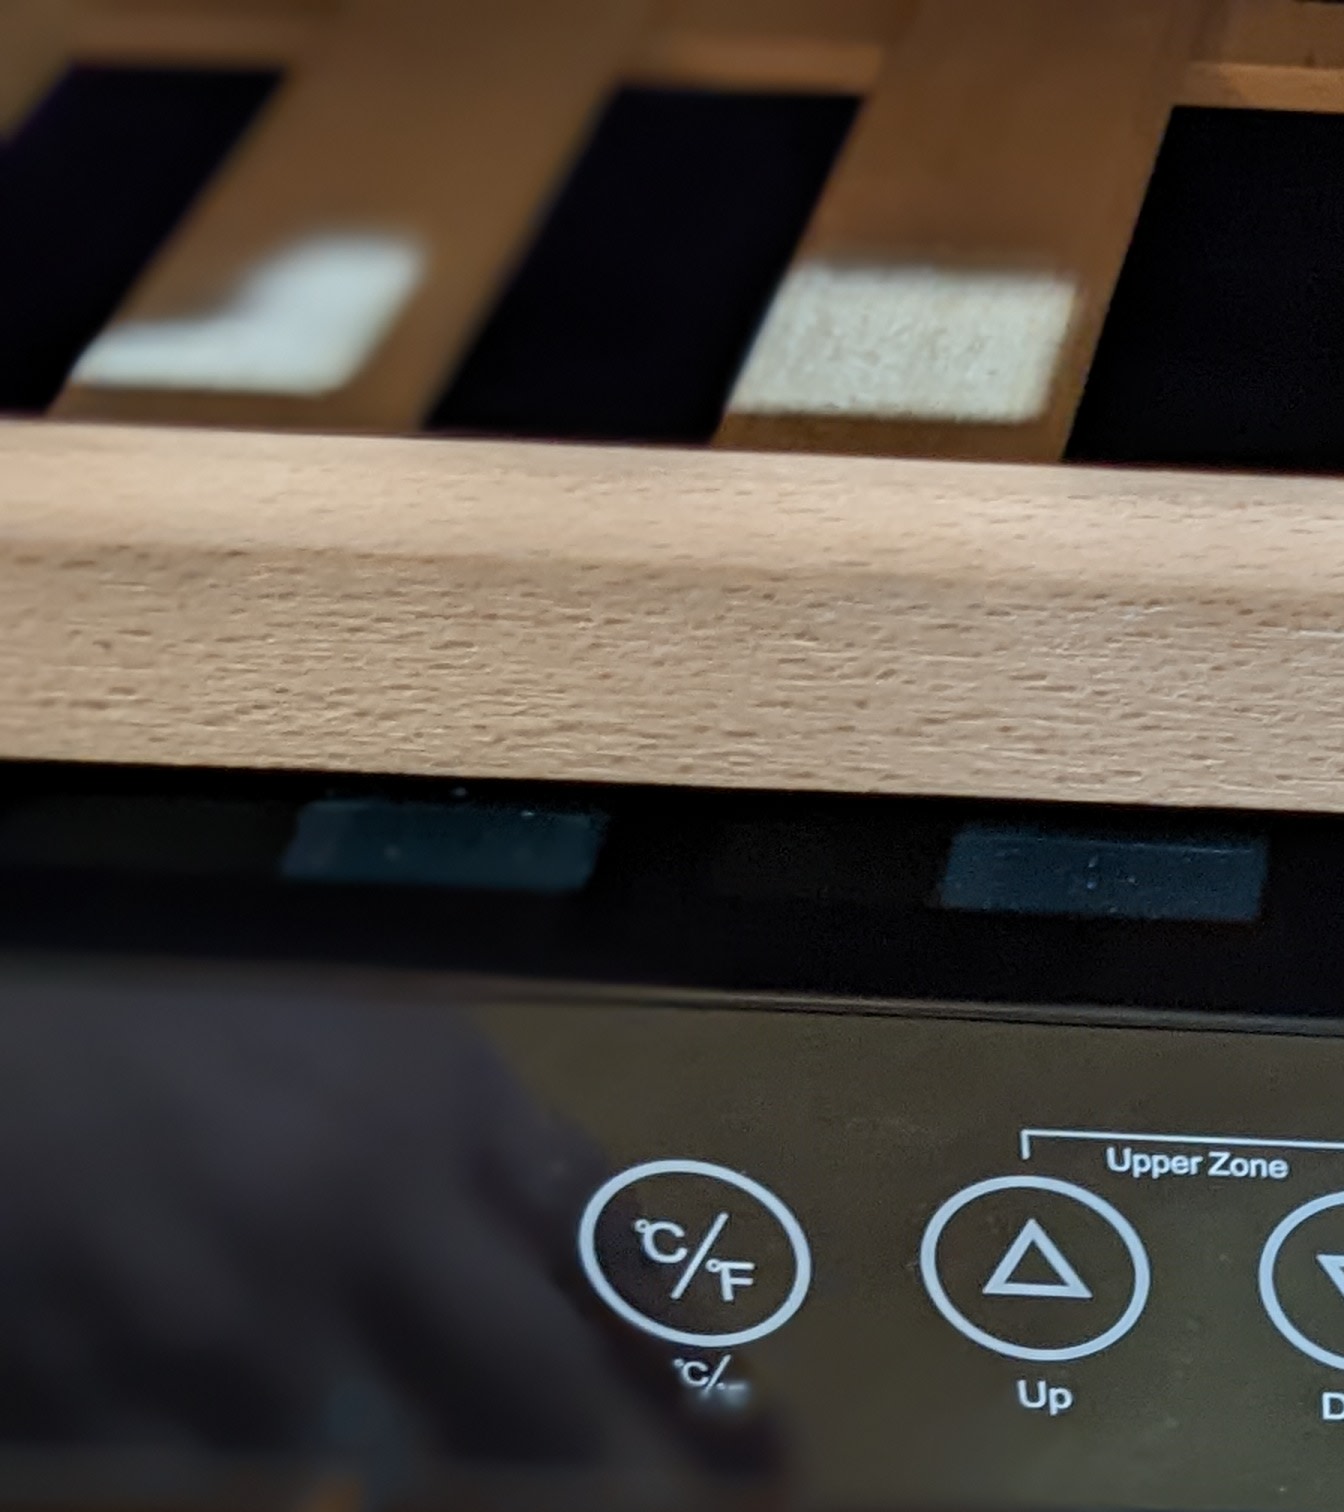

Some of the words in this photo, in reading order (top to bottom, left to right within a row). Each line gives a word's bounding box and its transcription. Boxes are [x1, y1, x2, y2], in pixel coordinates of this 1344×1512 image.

[1105, 1146, 1203, 1178] Upper
[1208, 1150, 1289, 1180] Zone
[1017, 1378, 1073, 1416] Up
